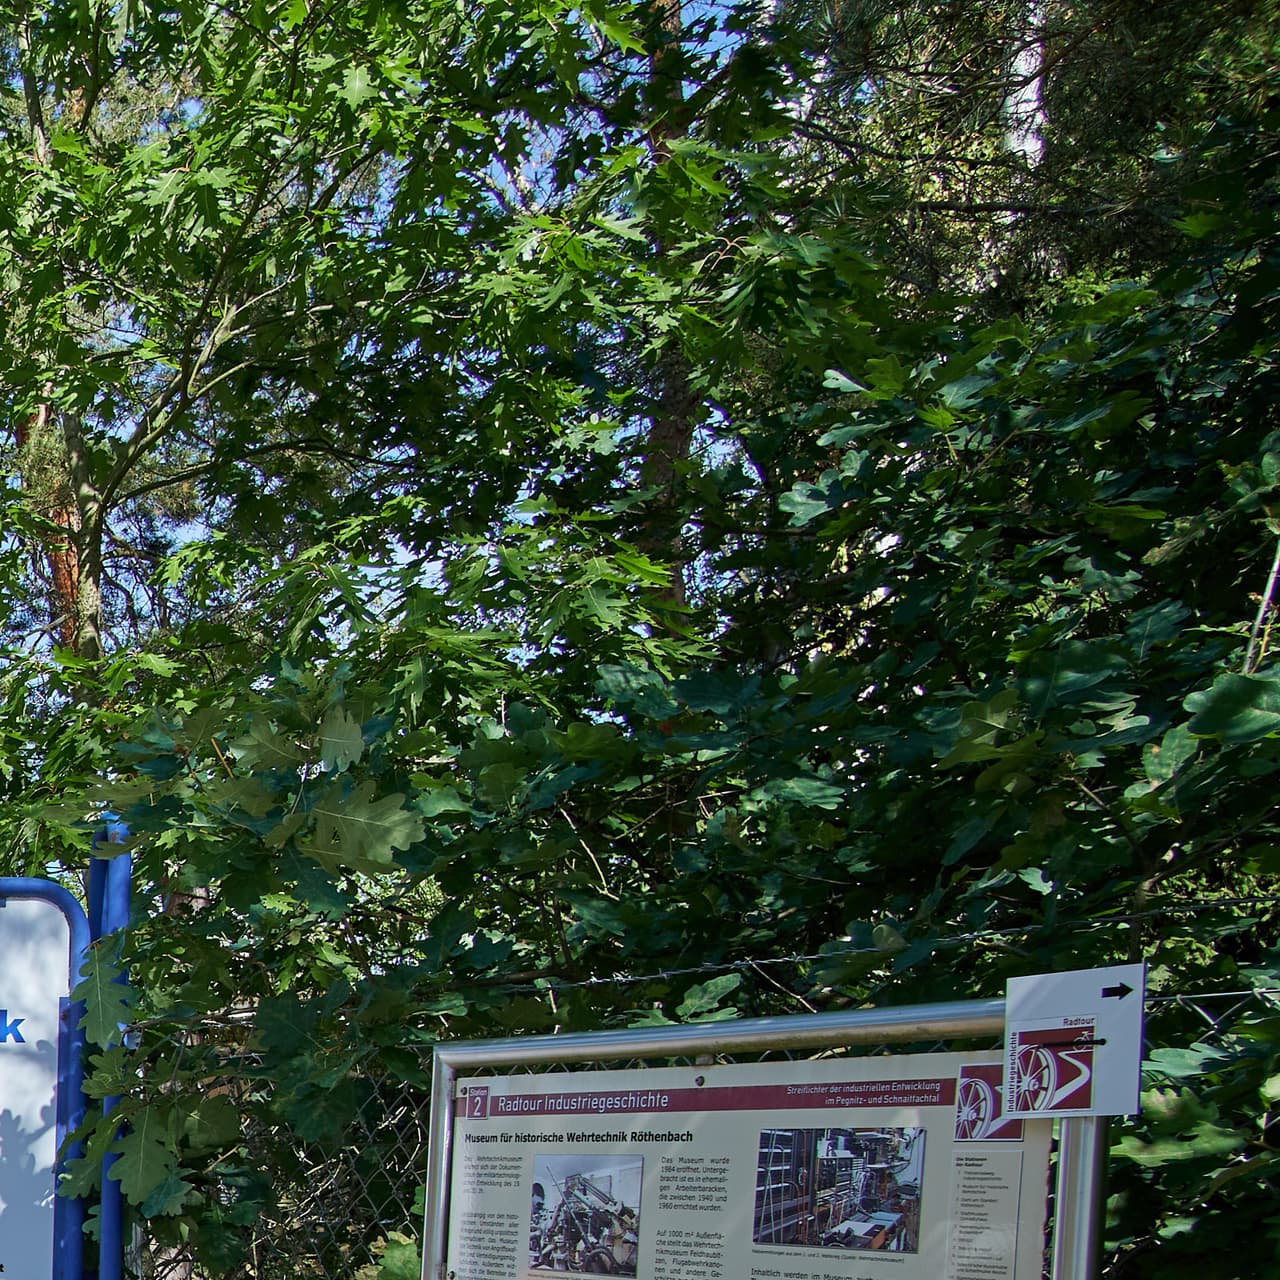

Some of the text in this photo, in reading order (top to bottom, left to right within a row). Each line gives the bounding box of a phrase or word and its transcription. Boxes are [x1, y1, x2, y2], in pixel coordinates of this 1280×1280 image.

[1063, 1018, 1095, 1026] Radtour
[1007, 1032, 1017, 1112] Industriegeschichte
[473, 1097, 481, 1115] 2
[498, 1092, 668, 1111] Radtour Industriegeschichte
[835, 1096, 866, 1105] Pegnitz-
[867, 1095, 882, 1103] und
[465, 1130, 692, 1143] Museum für historische Wehrtechnik Röthenbach
[751, 1268, 780, 1277] Inhaltlich
